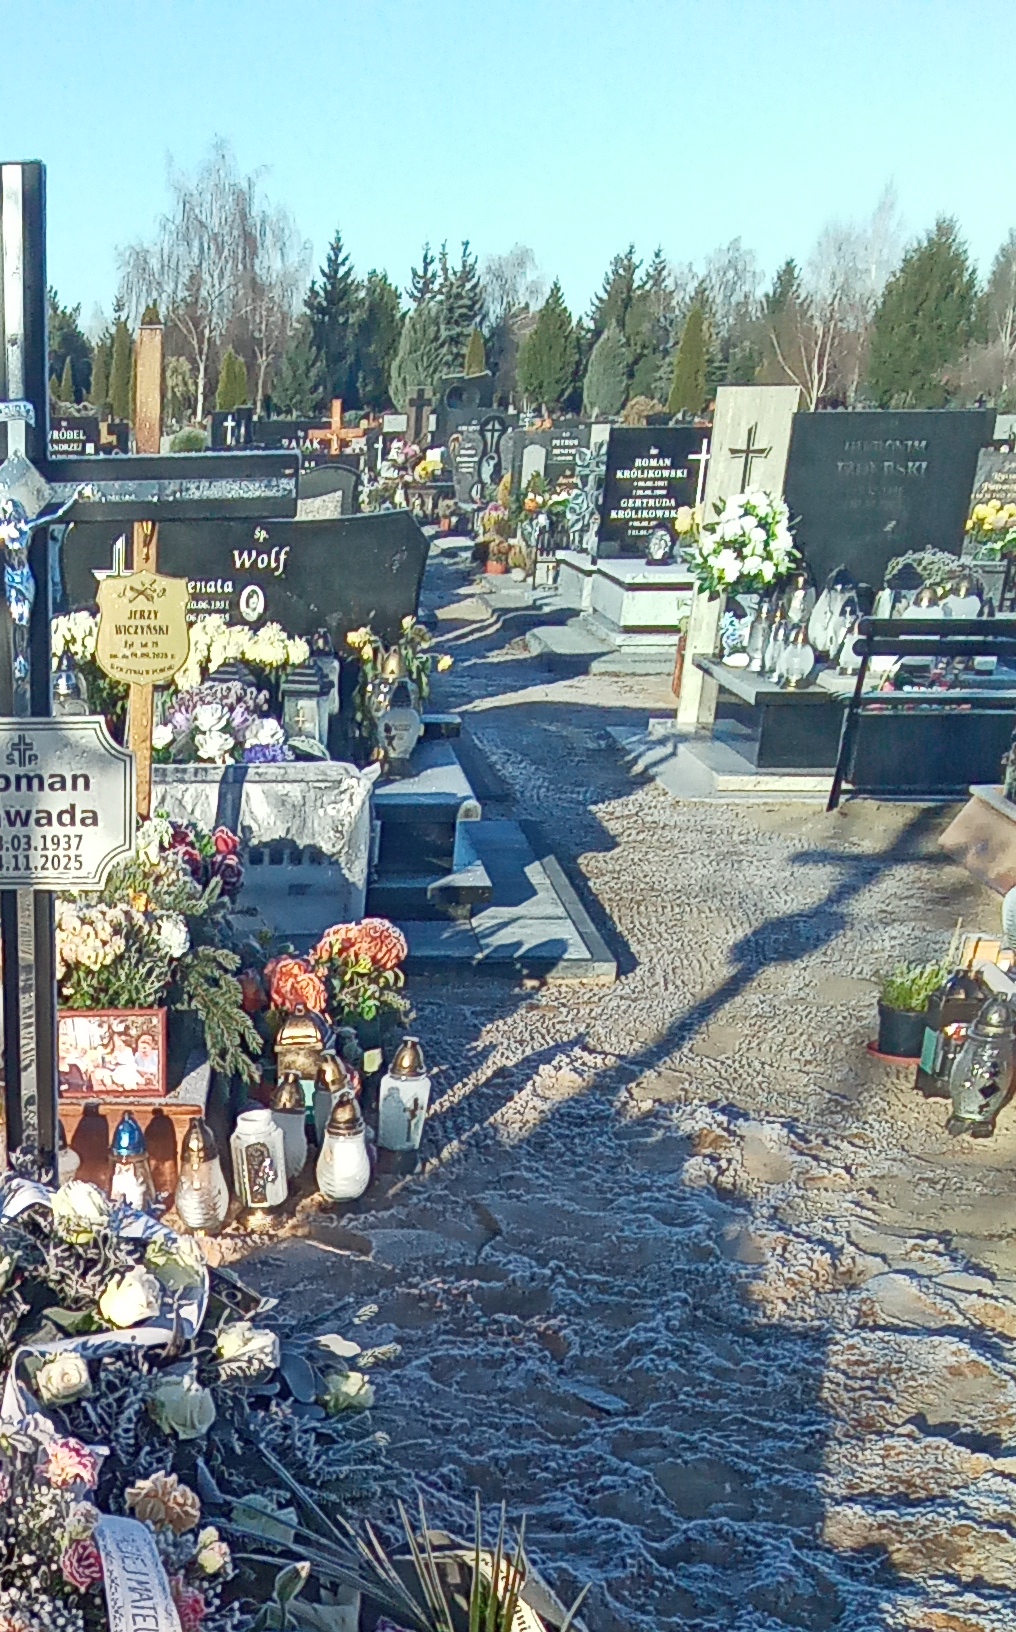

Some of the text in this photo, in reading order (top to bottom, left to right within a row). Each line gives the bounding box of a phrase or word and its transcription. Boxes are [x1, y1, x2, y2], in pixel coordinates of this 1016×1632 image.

[634, 457, 672, 467] ROMAN
[615, 468, 688, 479] KRÓLIKOWSKI
[620, 498, 676, 508] GERTRUDA
[233, 546, 291, 577] Wolf
[187, 579, 234, 594] enata
[128, 610, 159, 620] JERZY
[115, 624, 169, 635] WICZYŃSKI
